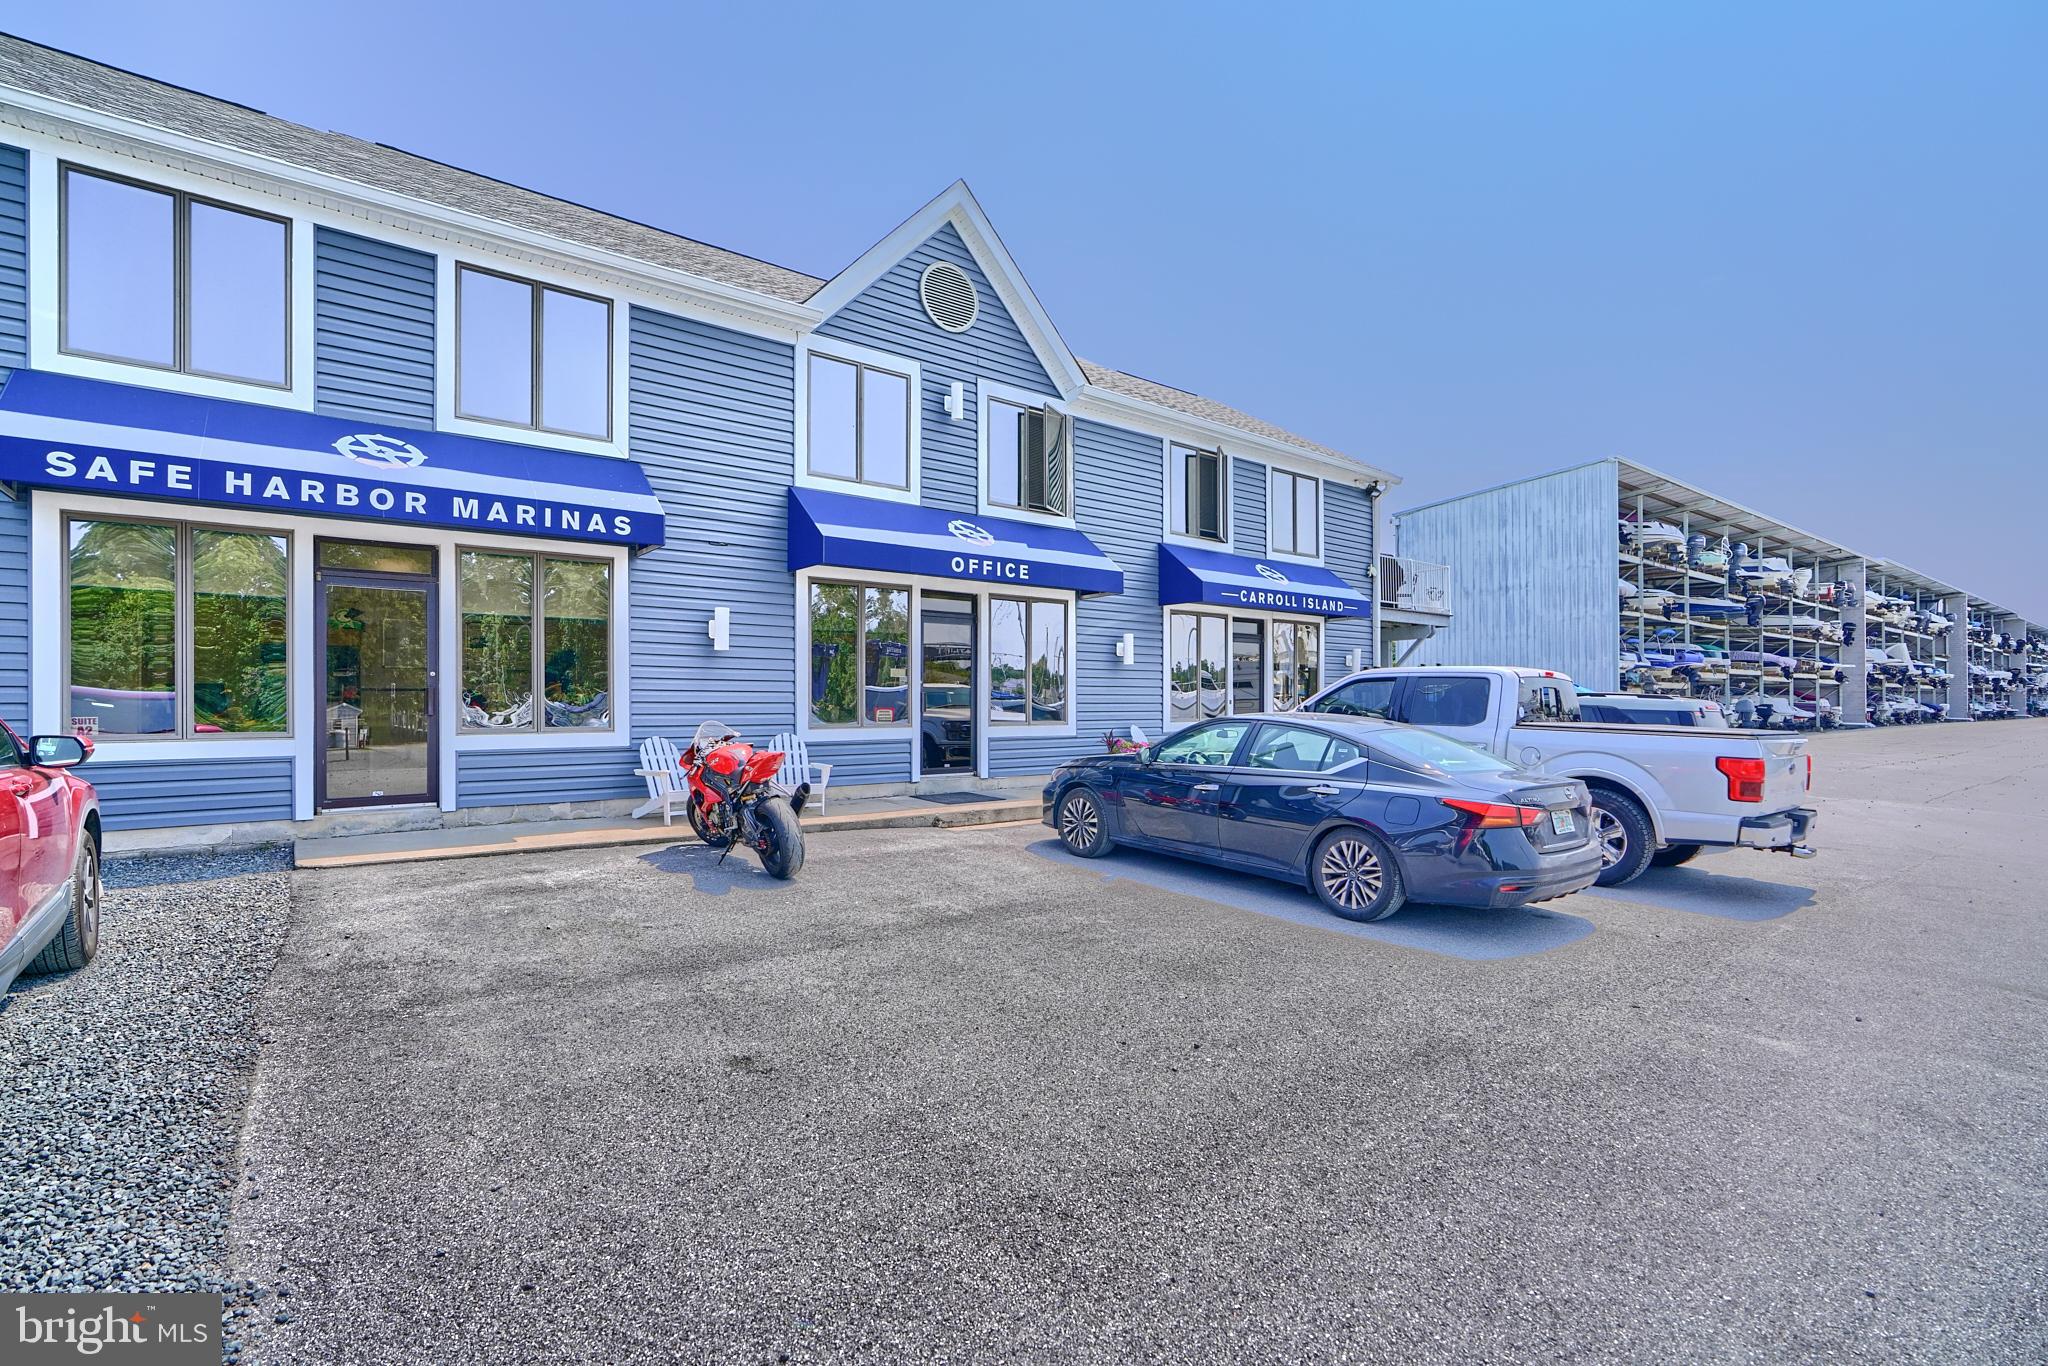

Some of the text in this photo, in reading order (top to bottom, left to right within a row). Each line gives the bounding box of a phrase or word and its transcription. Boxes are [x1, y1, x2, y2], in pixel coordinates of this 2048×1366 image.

[44, 450, 632, 536] SAFE HARBOR MARINAS
[951, 556, 1029, 580] OFFICE
[1240, 590, 1344, 612] CARROLL ISLAND
[71, 717, 97, 726] SUITE
[77, 725, 93, 736] A2
